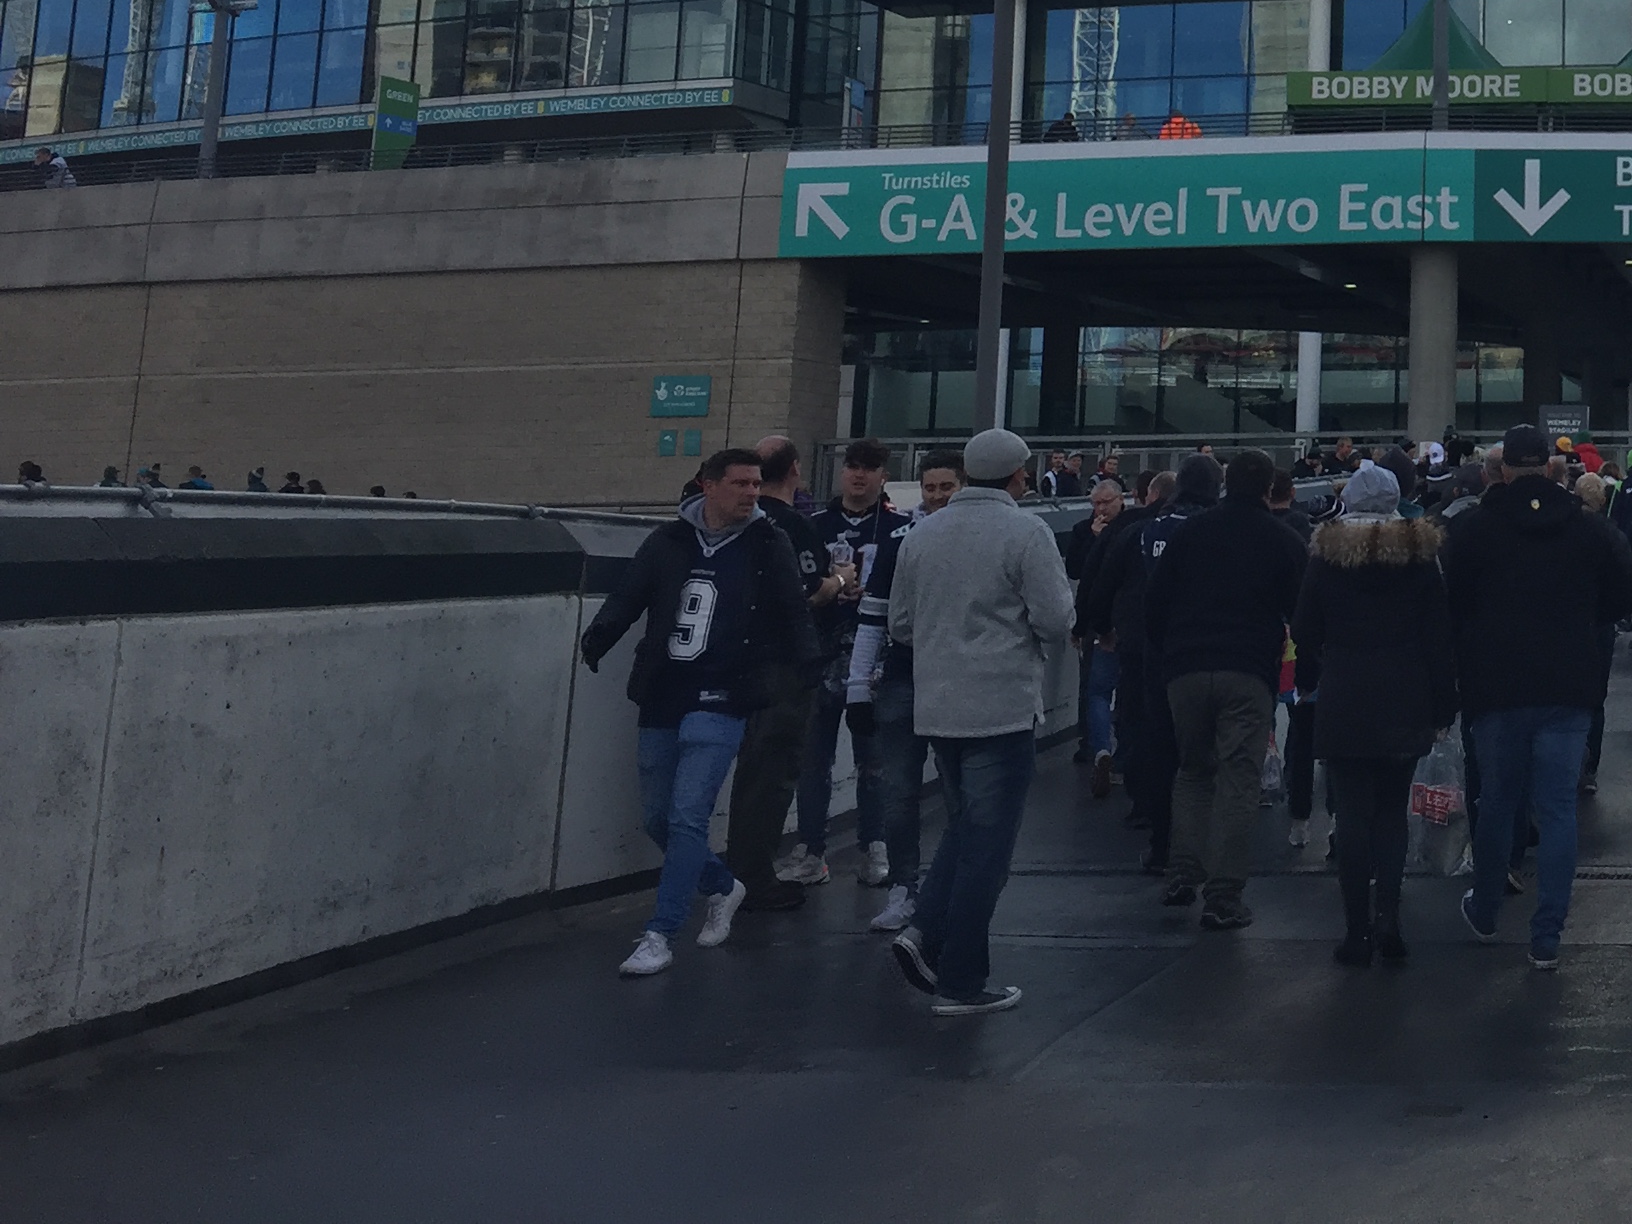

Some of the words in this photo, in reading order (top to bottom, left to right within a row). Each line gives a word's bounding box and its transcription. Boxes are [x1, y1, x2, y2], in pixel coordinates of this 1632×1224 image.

[386, 89, 413, 104] GREEN
[1311, 76, 1408, 99] BOBBY
[433, 105, 501, 121] CONNECTED
[503, 103, 520, 115] BY
[521, 102, 535, 114] EE
[550, 97, 608, 112] WEMBLEY
[609, 92, 683, 108] CONNECTED
[684, 91, 702, 104] BY
[704, 90, 719, 103] EE
[87, 137, 130, 151] WEMBLEY
[131, 131, 186, 147] CONNECTED
[225, 124, 271, 137] WEMBLEY
[273, 118, 336, 133] CONNECTED
[337, 116, 352, 126] BY
[353, 115, 365, 124] EE
[882, 171, 970, 192] Turnstiles
[880, 192, 976, 244] G-A
[1005, 192, 1039, 240] &
[1056, 186, 1188, 239] Level
[1205, 185, 1319, 235] Two
[1339, 184, 1459, 232] East
[667, 578, 718, 661] 9
